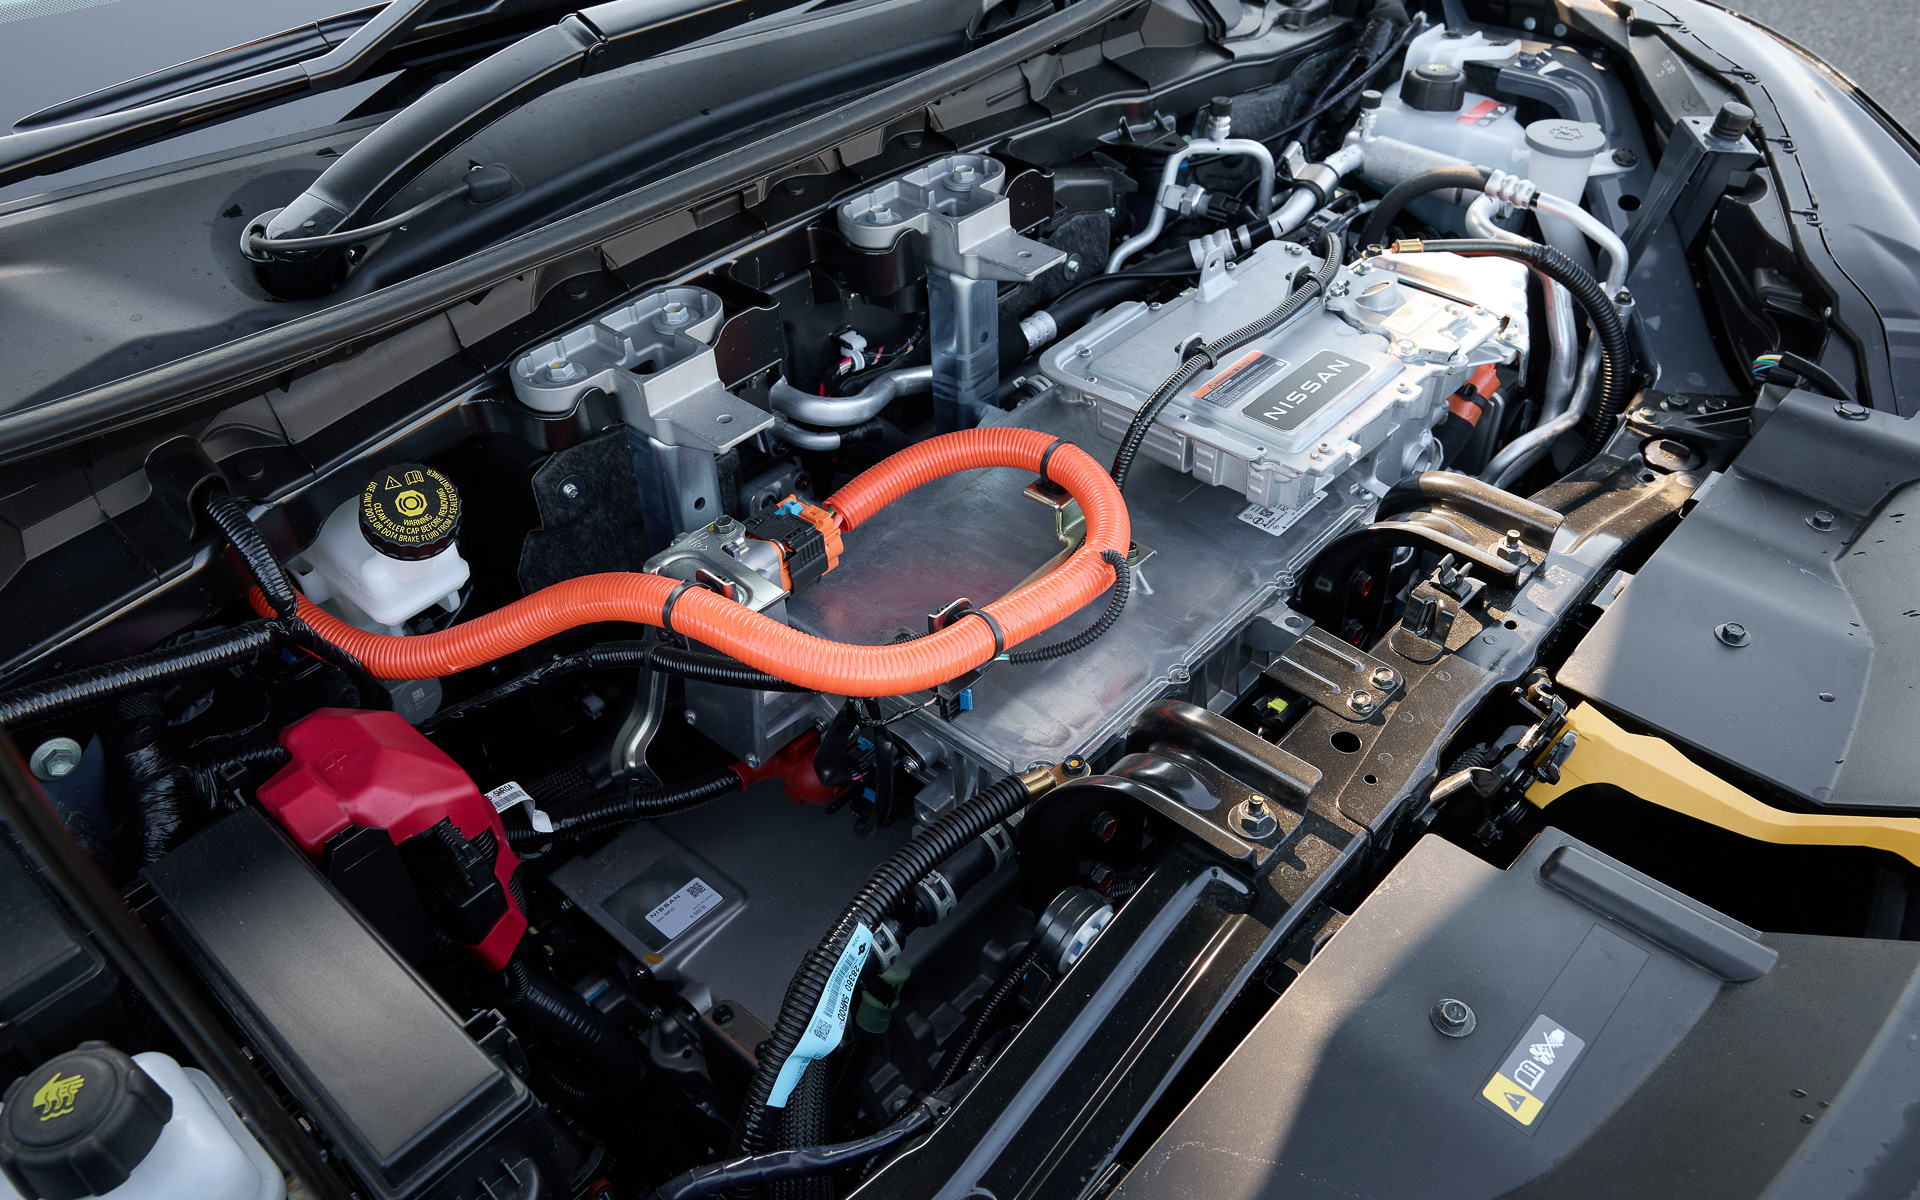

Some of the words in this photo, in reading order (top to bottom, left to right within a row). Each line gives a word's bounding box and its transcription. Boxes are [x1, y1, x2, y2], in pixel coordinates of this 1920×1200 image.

[1263, 359, 1351, 421] NISSAN
[366, 481, 378, 493] USE
[426, 469, 454, 494] CONTAINER
[363, 492, 373, 508] ONLY
[448, 493, 458, 515] SEALED
[364, 508, 375, 523] DOT3
[373, 502, 388, 522] CLEAN
[384, 519, 405, 533] FILLER
[420, 515, 444, 533] BEFORE
[436, 487, 449, 517] REMOVING
[373, 521, 381, 531] OR
[403, 513, 433, 526] WARNING
[437, 518, 453, 533] FROM
[381, 527, 397, 540] DOT4
[398, 534, 420, 543] BRAKE
[421, 530, 440, 541] FLUID
[650, 894, 681, 919] NISSAN
[844, 964, 860, 992] 28360
